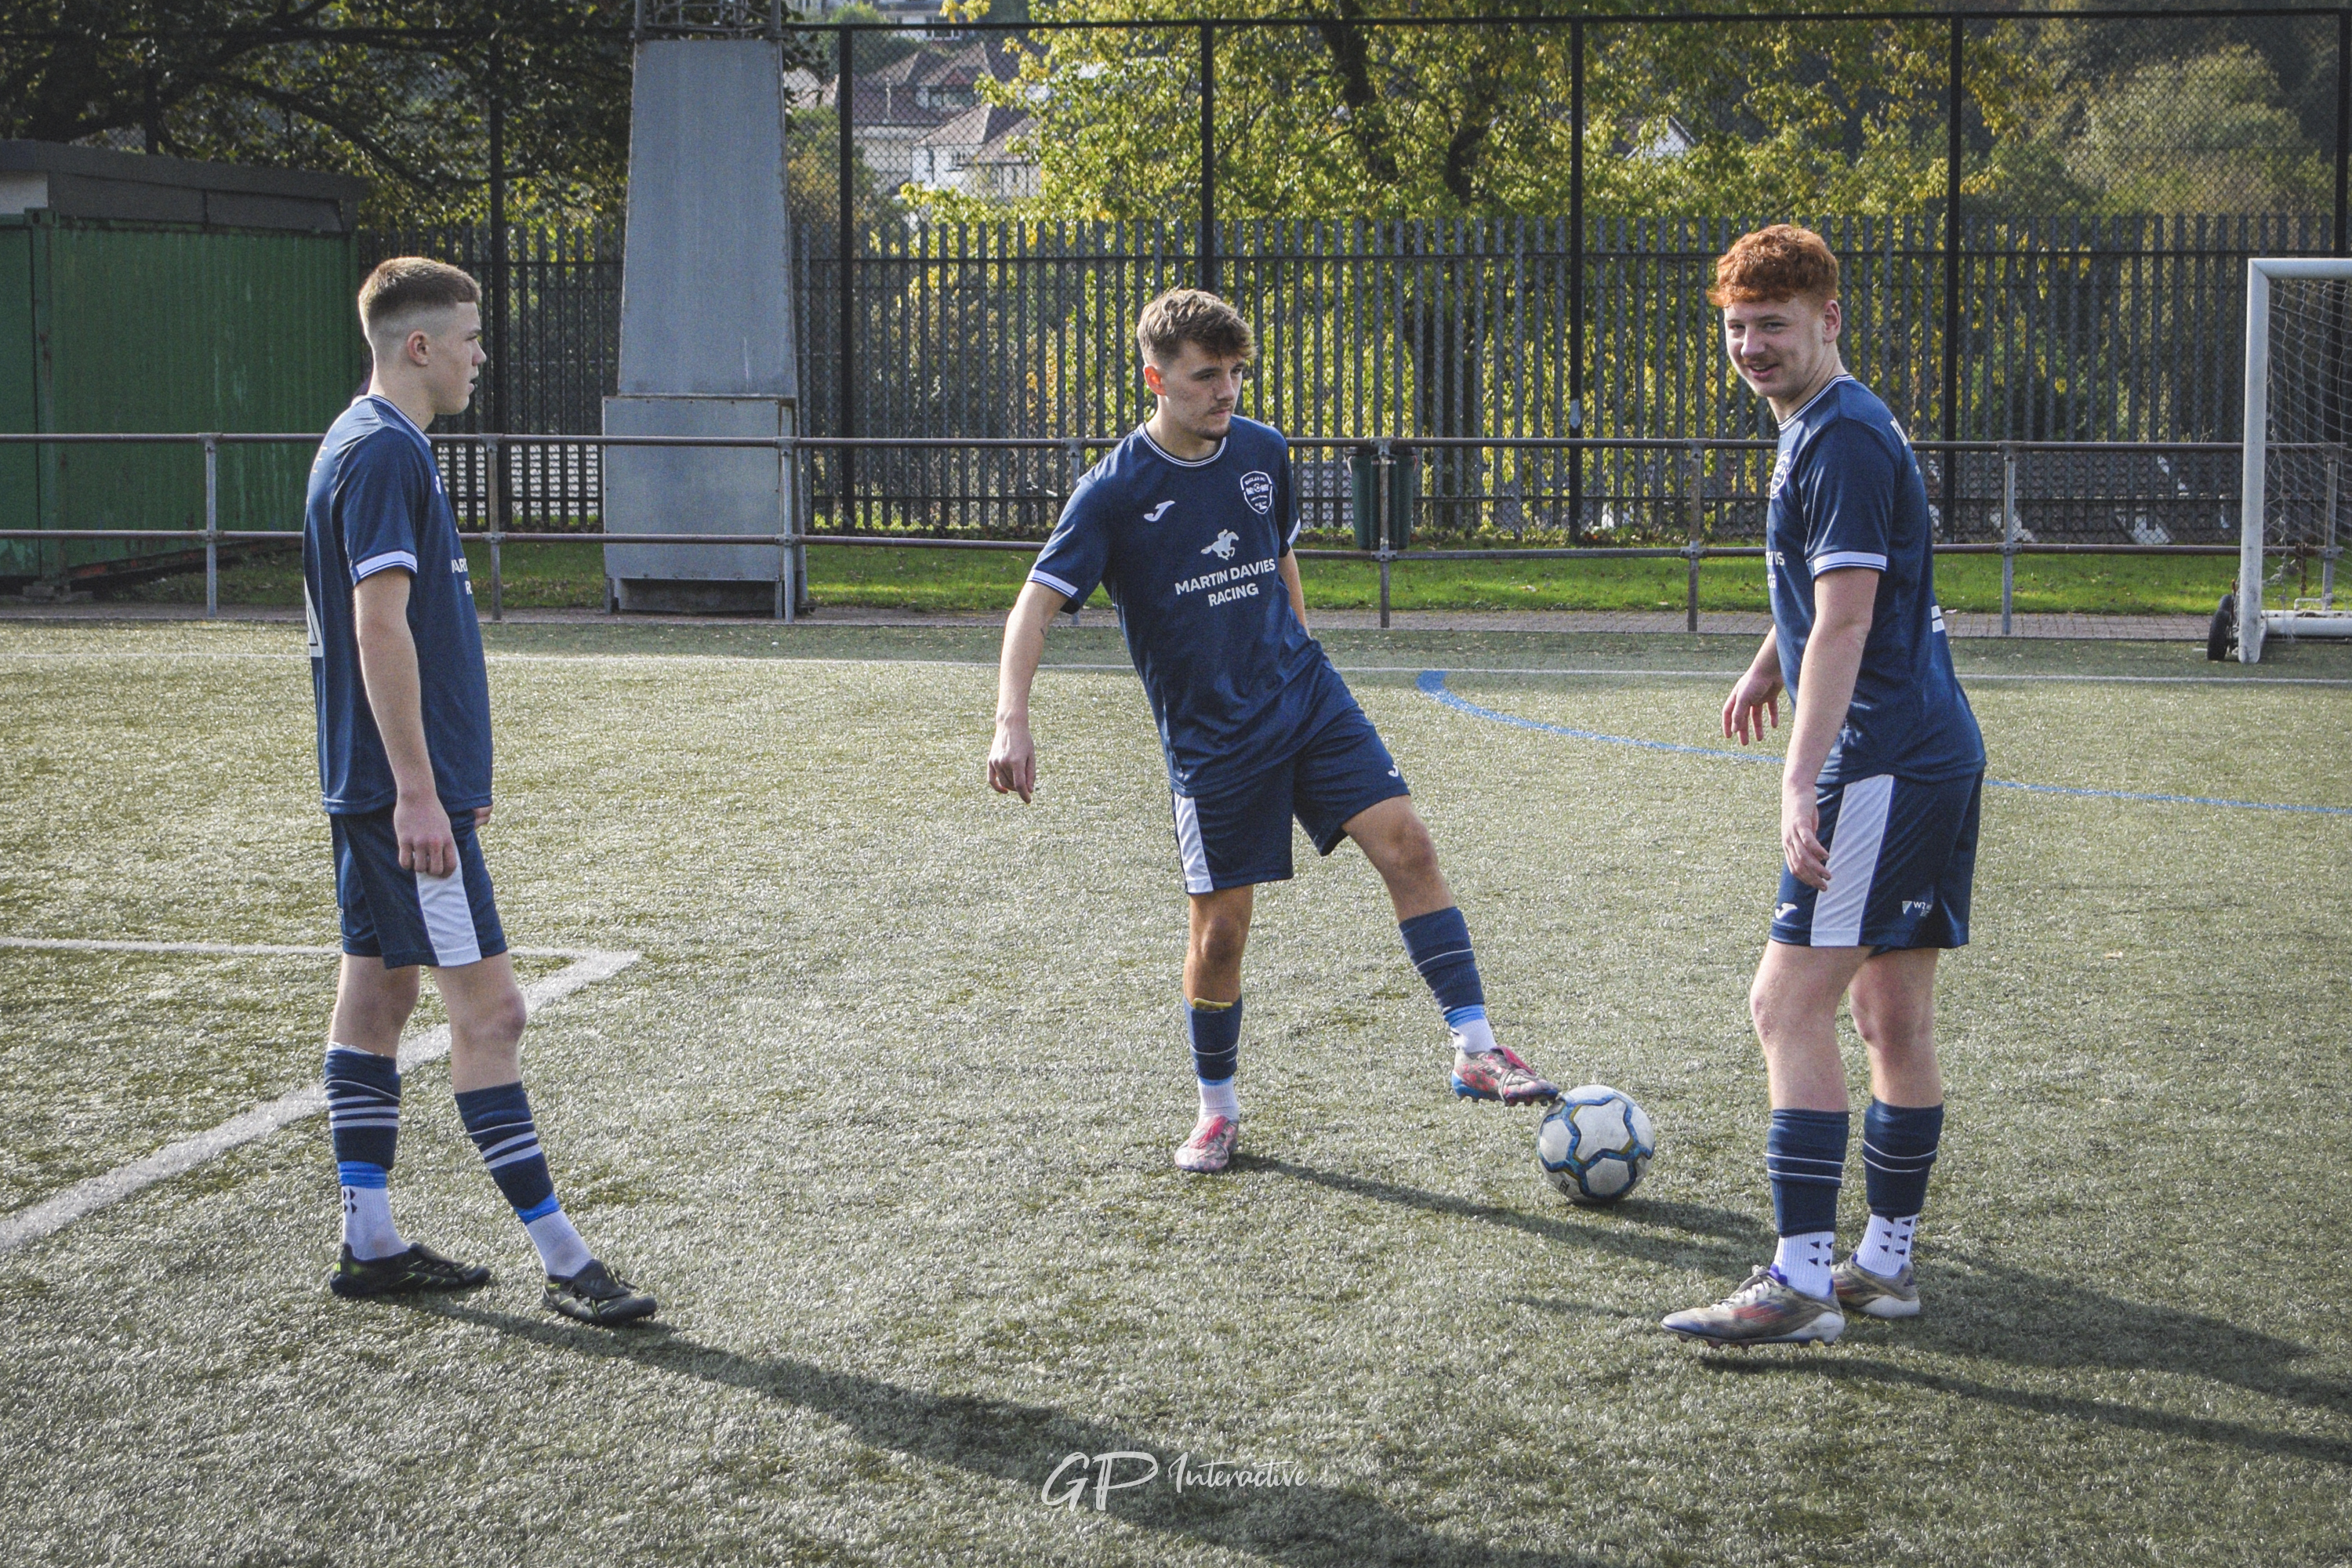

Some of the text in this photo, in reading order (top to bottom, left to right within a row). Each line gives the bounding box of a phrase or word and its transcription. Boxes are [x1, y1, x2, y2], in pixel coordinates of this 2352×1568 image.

[1174, 557, 1276, 595] MARTIN DAVIES
[1207, 583, 1260, 608] RACING
